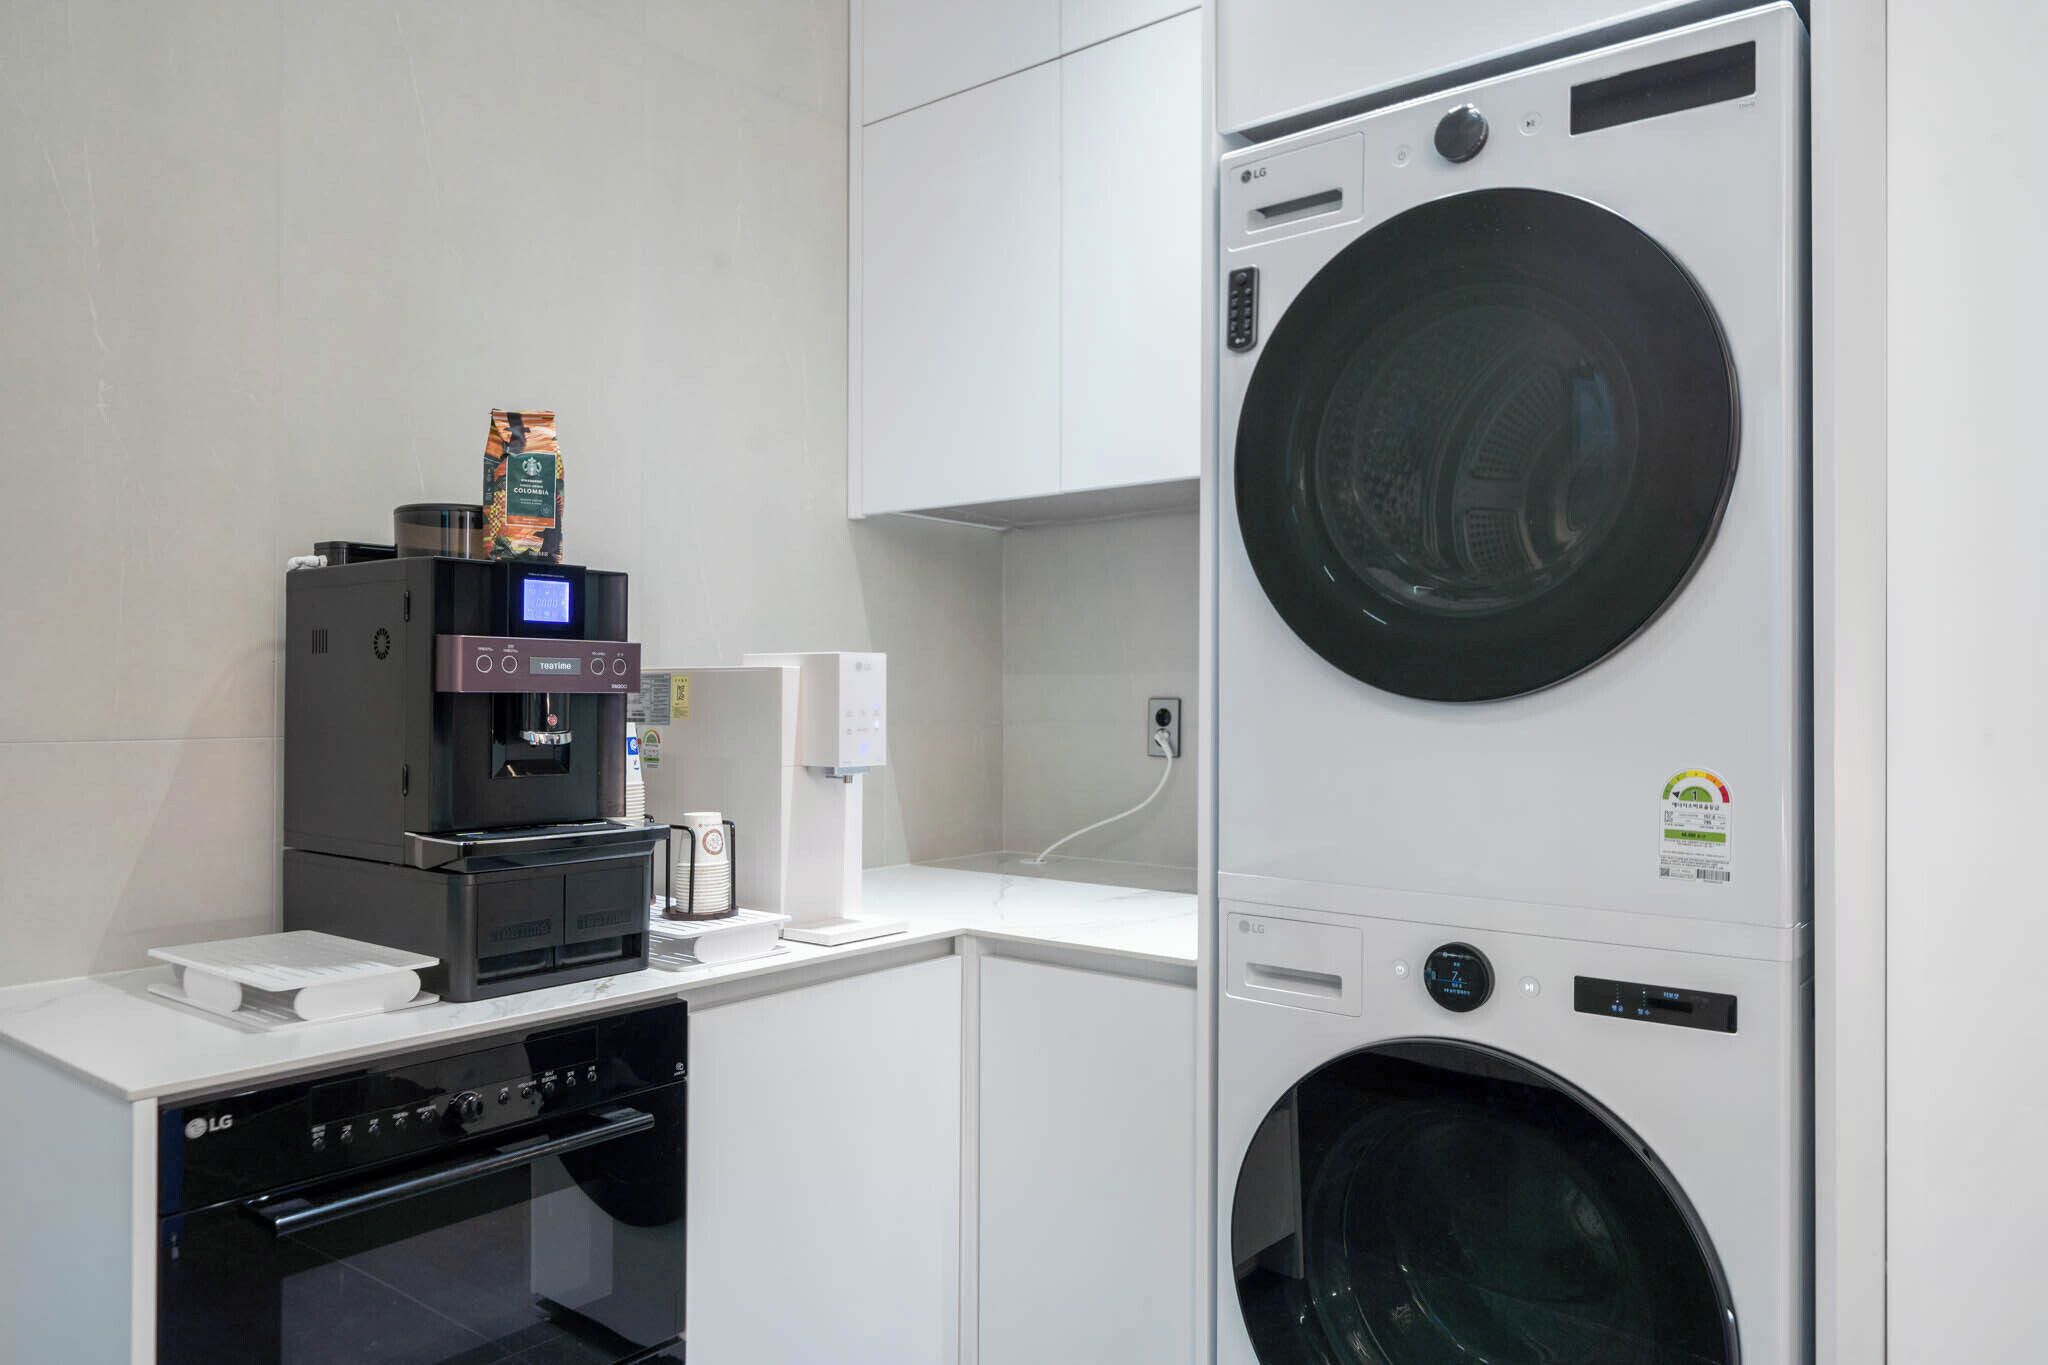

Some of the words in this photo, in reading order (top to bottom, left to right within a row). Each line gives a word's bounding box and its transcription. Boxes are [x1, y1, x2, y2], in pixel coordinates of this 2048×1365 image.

[1253, 167, 1267, 179] LG
[513, 487, 549, 496] COLOMBIA
[1692, 790, 1697, 801] 1
[1252, 923, 1265, 934] LG
[209, 1114, 233, 1132] LG
